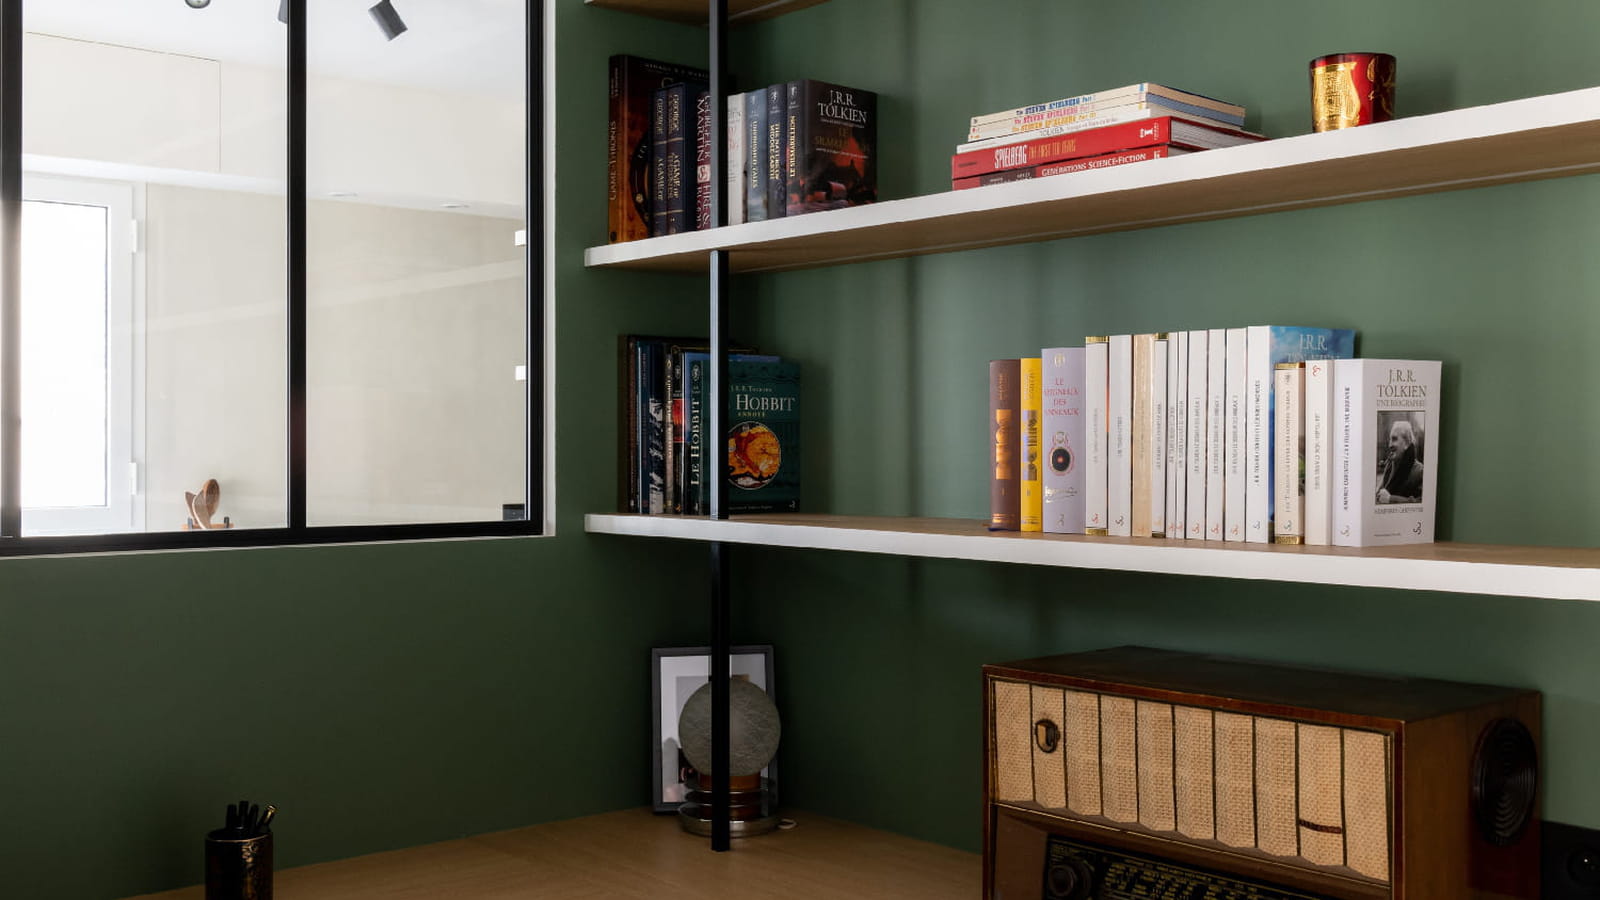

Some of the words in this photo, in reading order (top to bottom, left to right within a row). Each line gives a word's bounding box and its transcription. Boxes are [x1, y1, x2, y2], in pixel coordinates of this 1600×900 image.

[817, 102, 868, 123] TOLKIEN
[1023, 113, 1045, 124] STEVEN
[1025, 104, 1046, 114] STEVEN
[696, 99, 704, 162] MARTIN
[994, 144, 1027, 169] SPIELBERG
[1055, 377, 1064, 386] LE
[1376, 384, 1427, 398] TOLKIEN
[735, 394, 796, 411] HOBBIT
[690, 398, 700, 457] HOBBIT
[690, 463, 700, 485] LE
